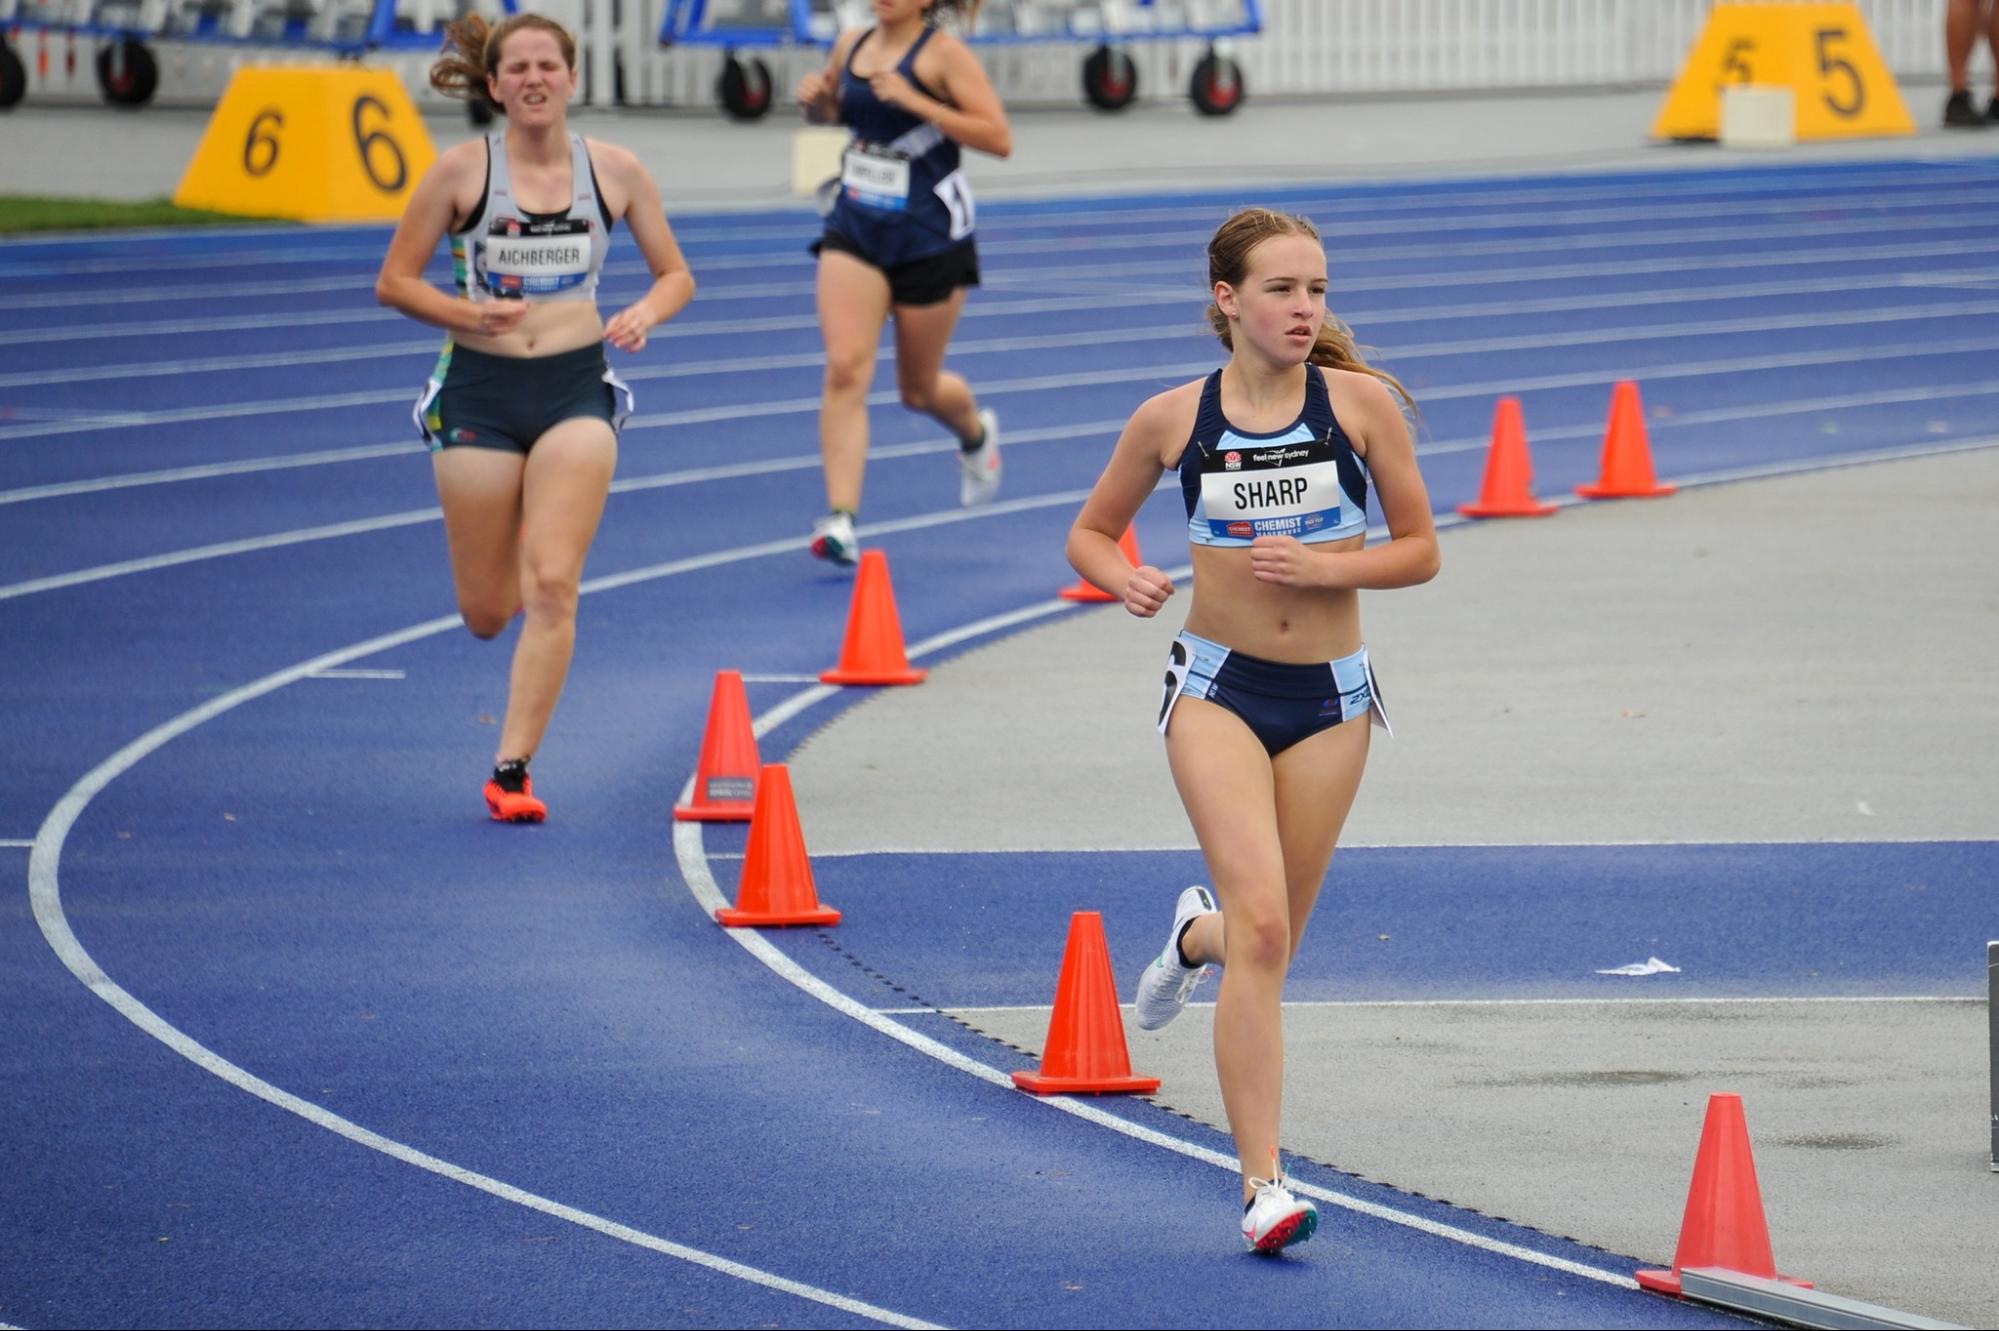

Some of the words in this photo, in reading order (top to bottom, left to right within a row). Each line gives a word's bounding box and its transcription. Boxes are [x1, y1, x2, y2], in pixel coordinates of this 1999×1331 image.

[1716, 38, 1757, 93] 5
[1817, 28, 1866, 116] 5
[243, 109, 284, 177] 6
[352, 94, 408, 193] 6
[498, 247, 581, 267] AICHBERGER
[1225, 461, 1242, 469] NSW
[1253, 453, 1267, 463] feel
[1267, 452, 1284, 462] new
[1284, 450, 1309, 462] sydney
[1233, 477, 1308, 510] SHARP
[1254, 517, 1301, 531] CHEMIST
